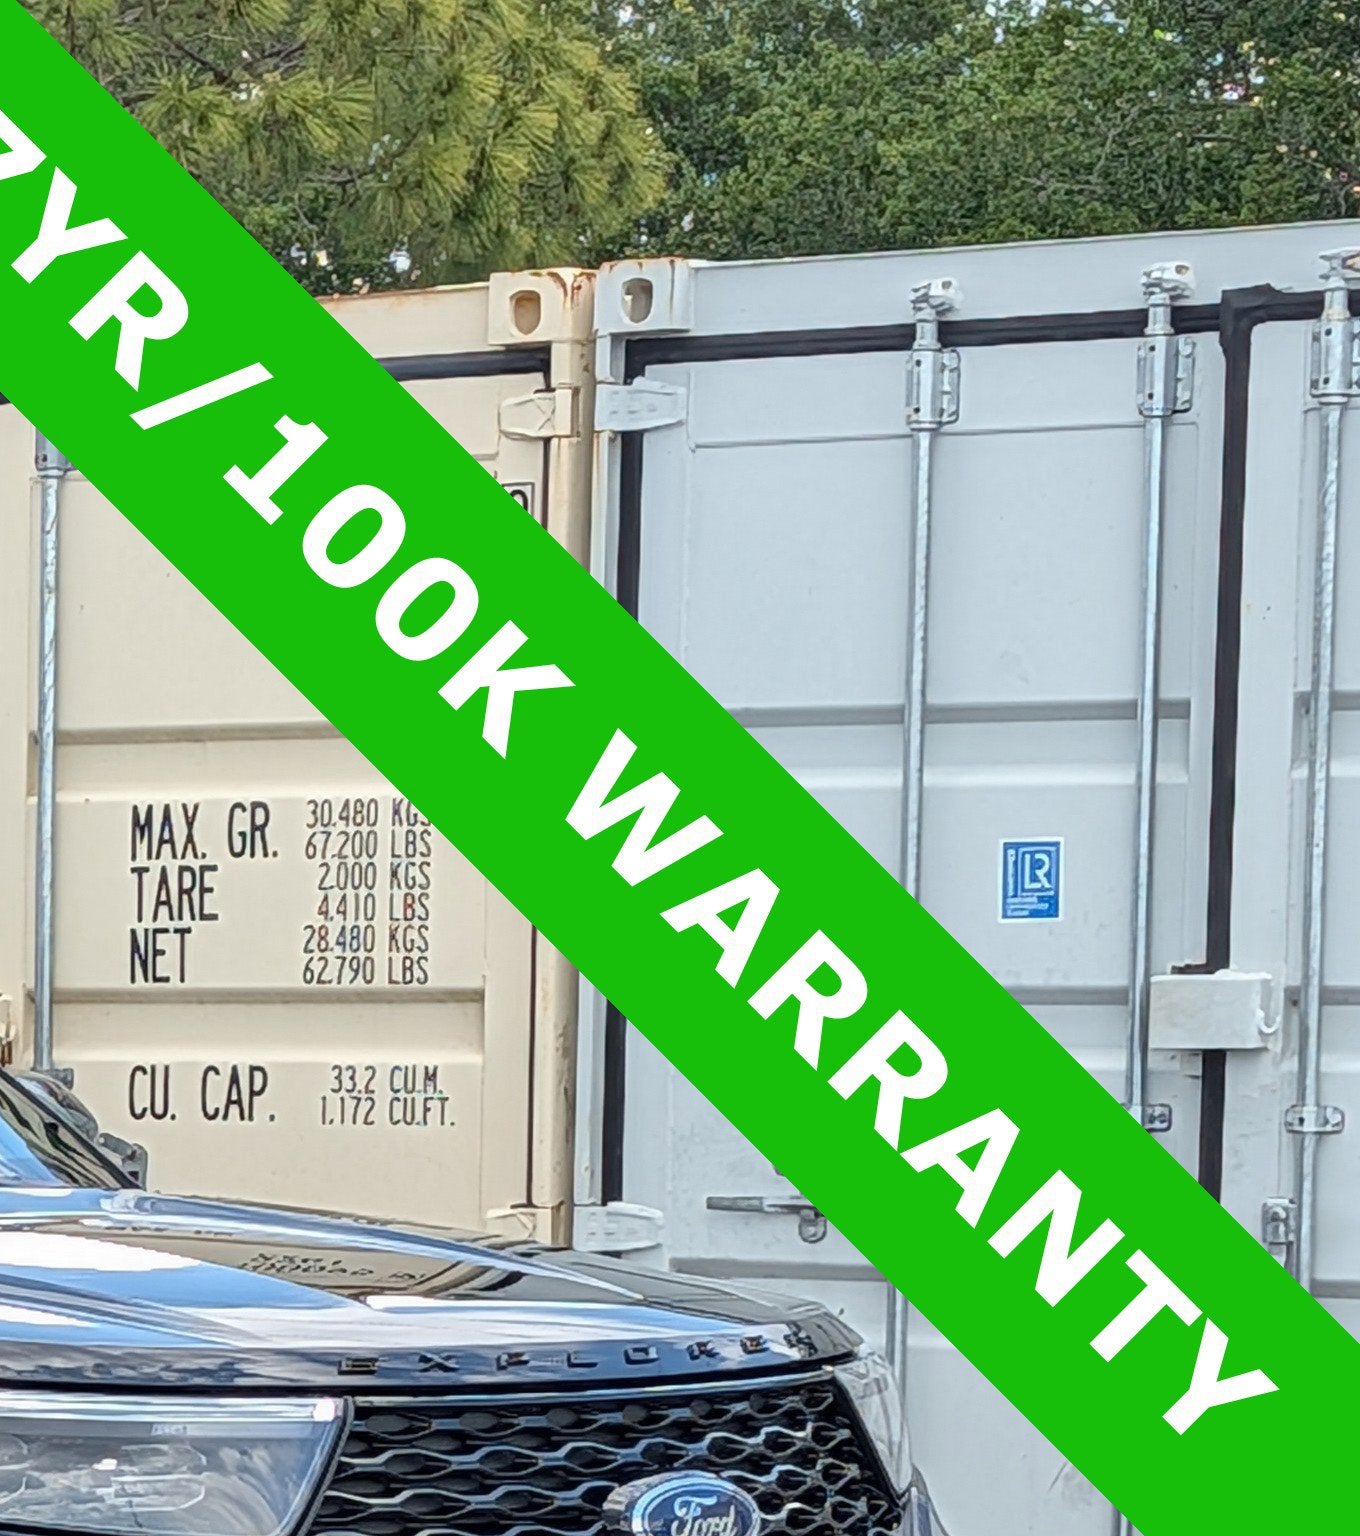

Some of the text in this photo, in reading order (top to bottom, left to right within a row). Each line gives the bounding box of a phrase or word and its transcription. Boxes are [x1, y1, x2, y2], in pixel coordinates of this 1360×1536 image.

[391, 796, 432, 828] KG
[130, 800, 279, 861] MAX. GR.
[390, 828, 432, 859] LBS
[389, 860, 432, 891] KGS
[1023, 851, 1053, 890] LR
[130, 863, 219, 922] TARE
[389, 892, 430, 922] LBS
[388, 924, 429, 954] KGS
[129, 926, 192, 985] NET
[387, 955, 429, 985] LBS
[128, 1064, 277, 1123] CU. CAP.
[329, 1064, 378, 1094] 33.2
